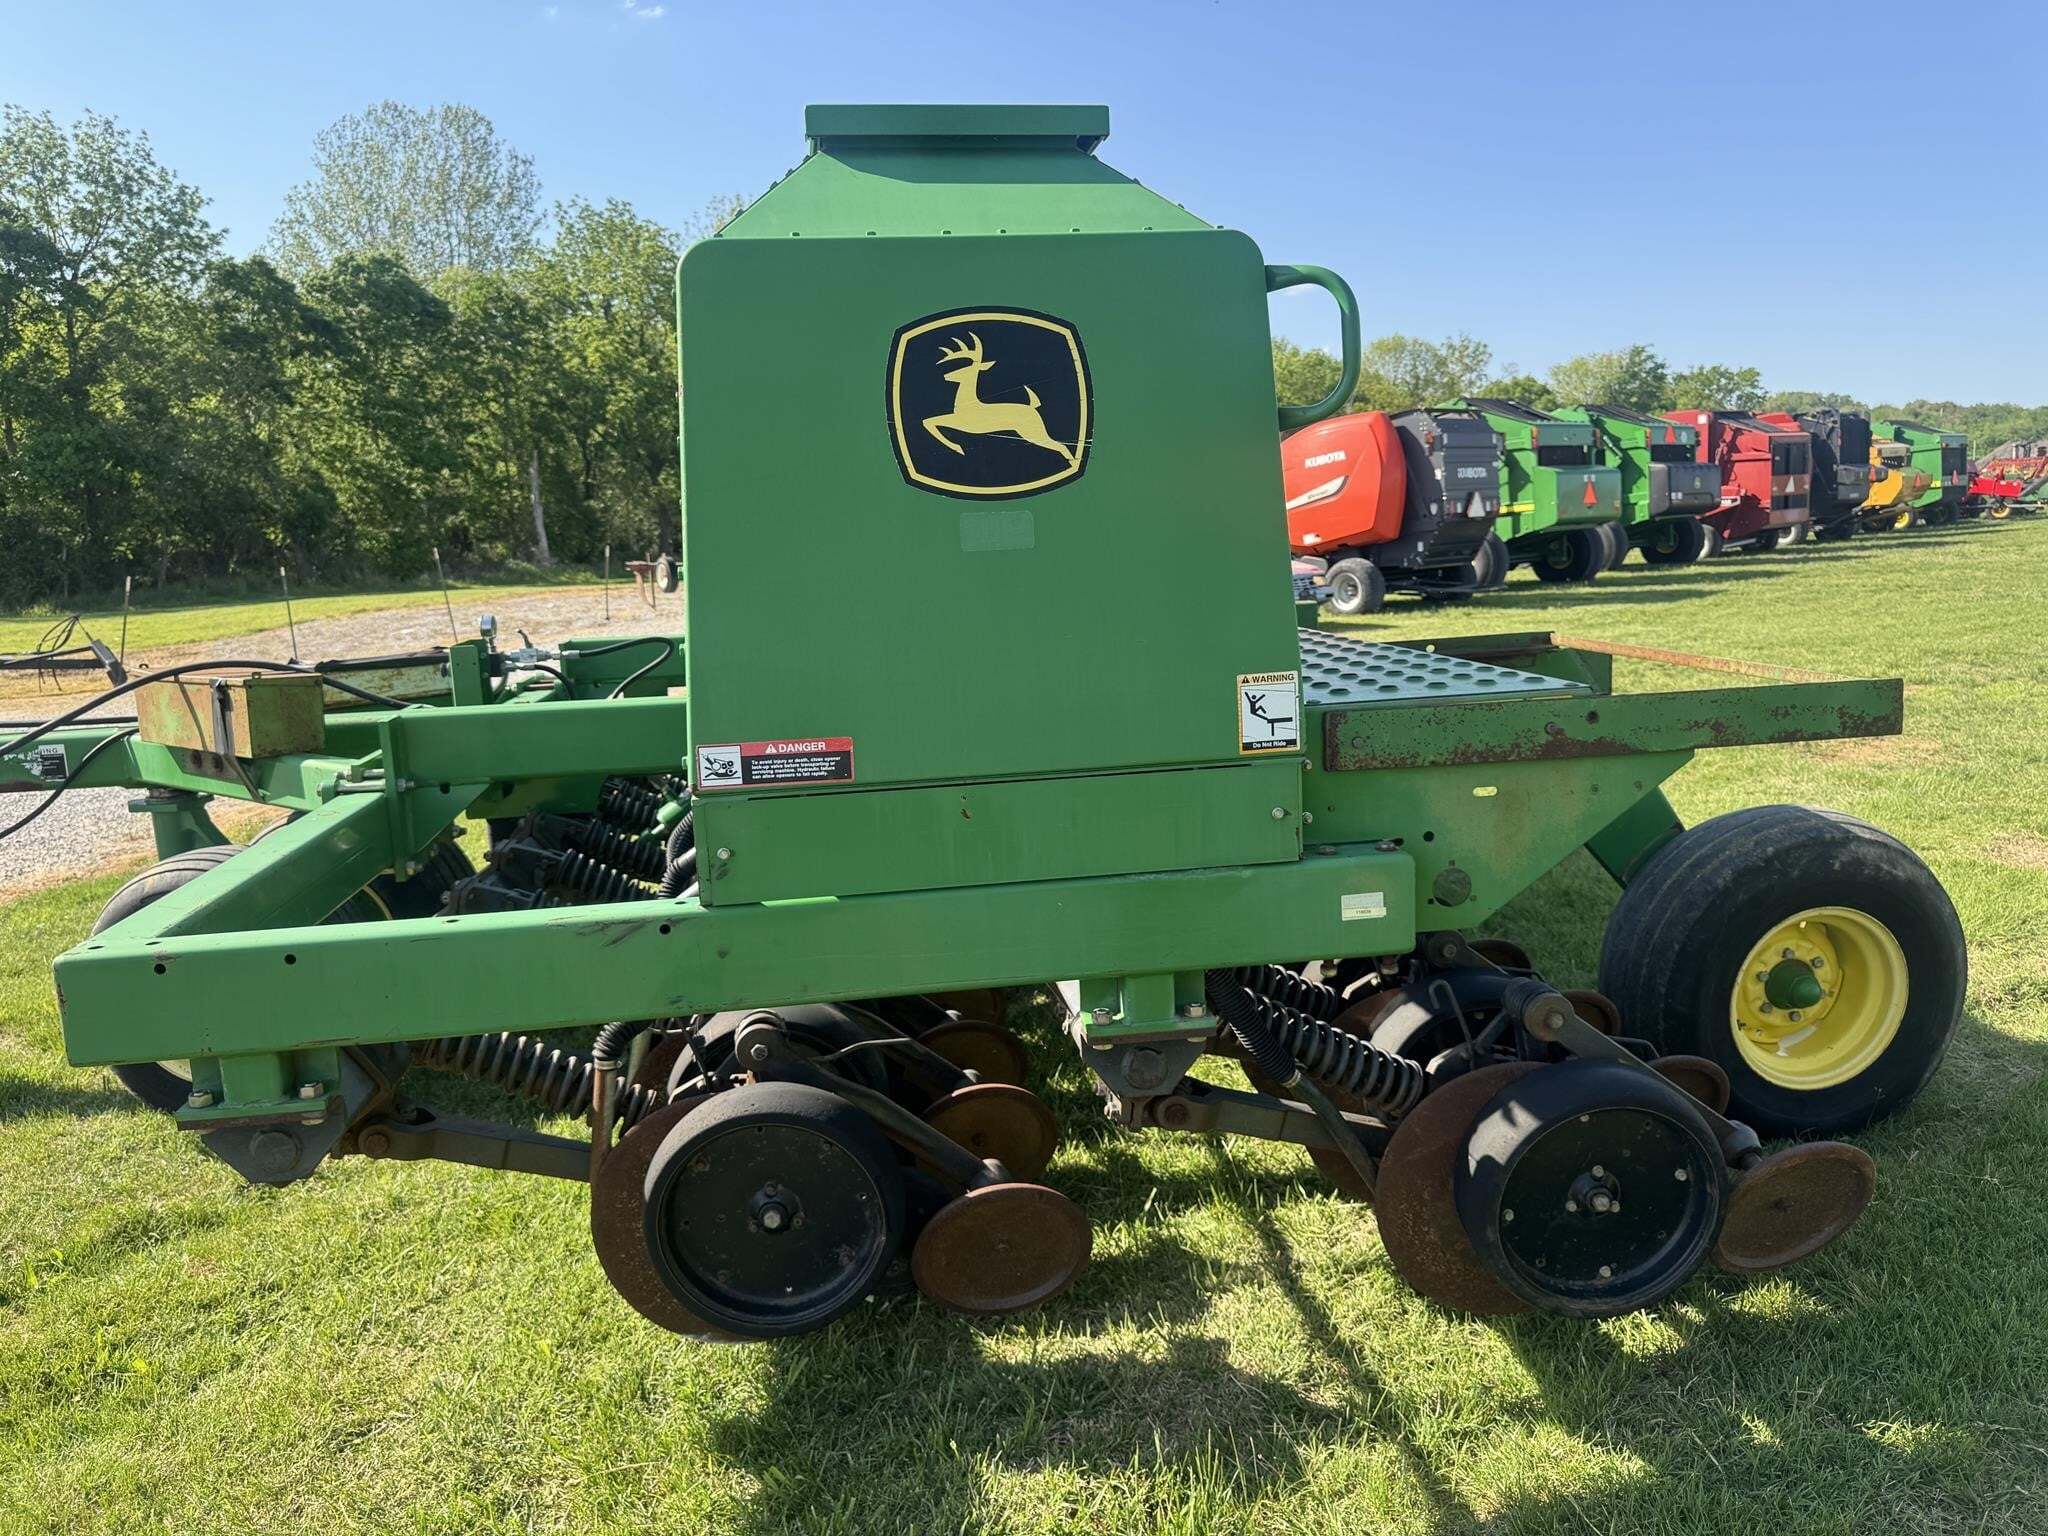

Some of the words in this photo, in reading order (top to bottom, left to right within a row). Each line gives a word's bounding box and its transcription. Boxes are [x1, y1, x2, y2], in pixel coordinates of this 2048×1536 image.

[1305, 451, 1347, 469] KUBOTA
[1457, 467, 1488, 479] KUBOTA
[1252, 673, 1295, 683] WARNING
[779, 741, 826, 753] DANGER
